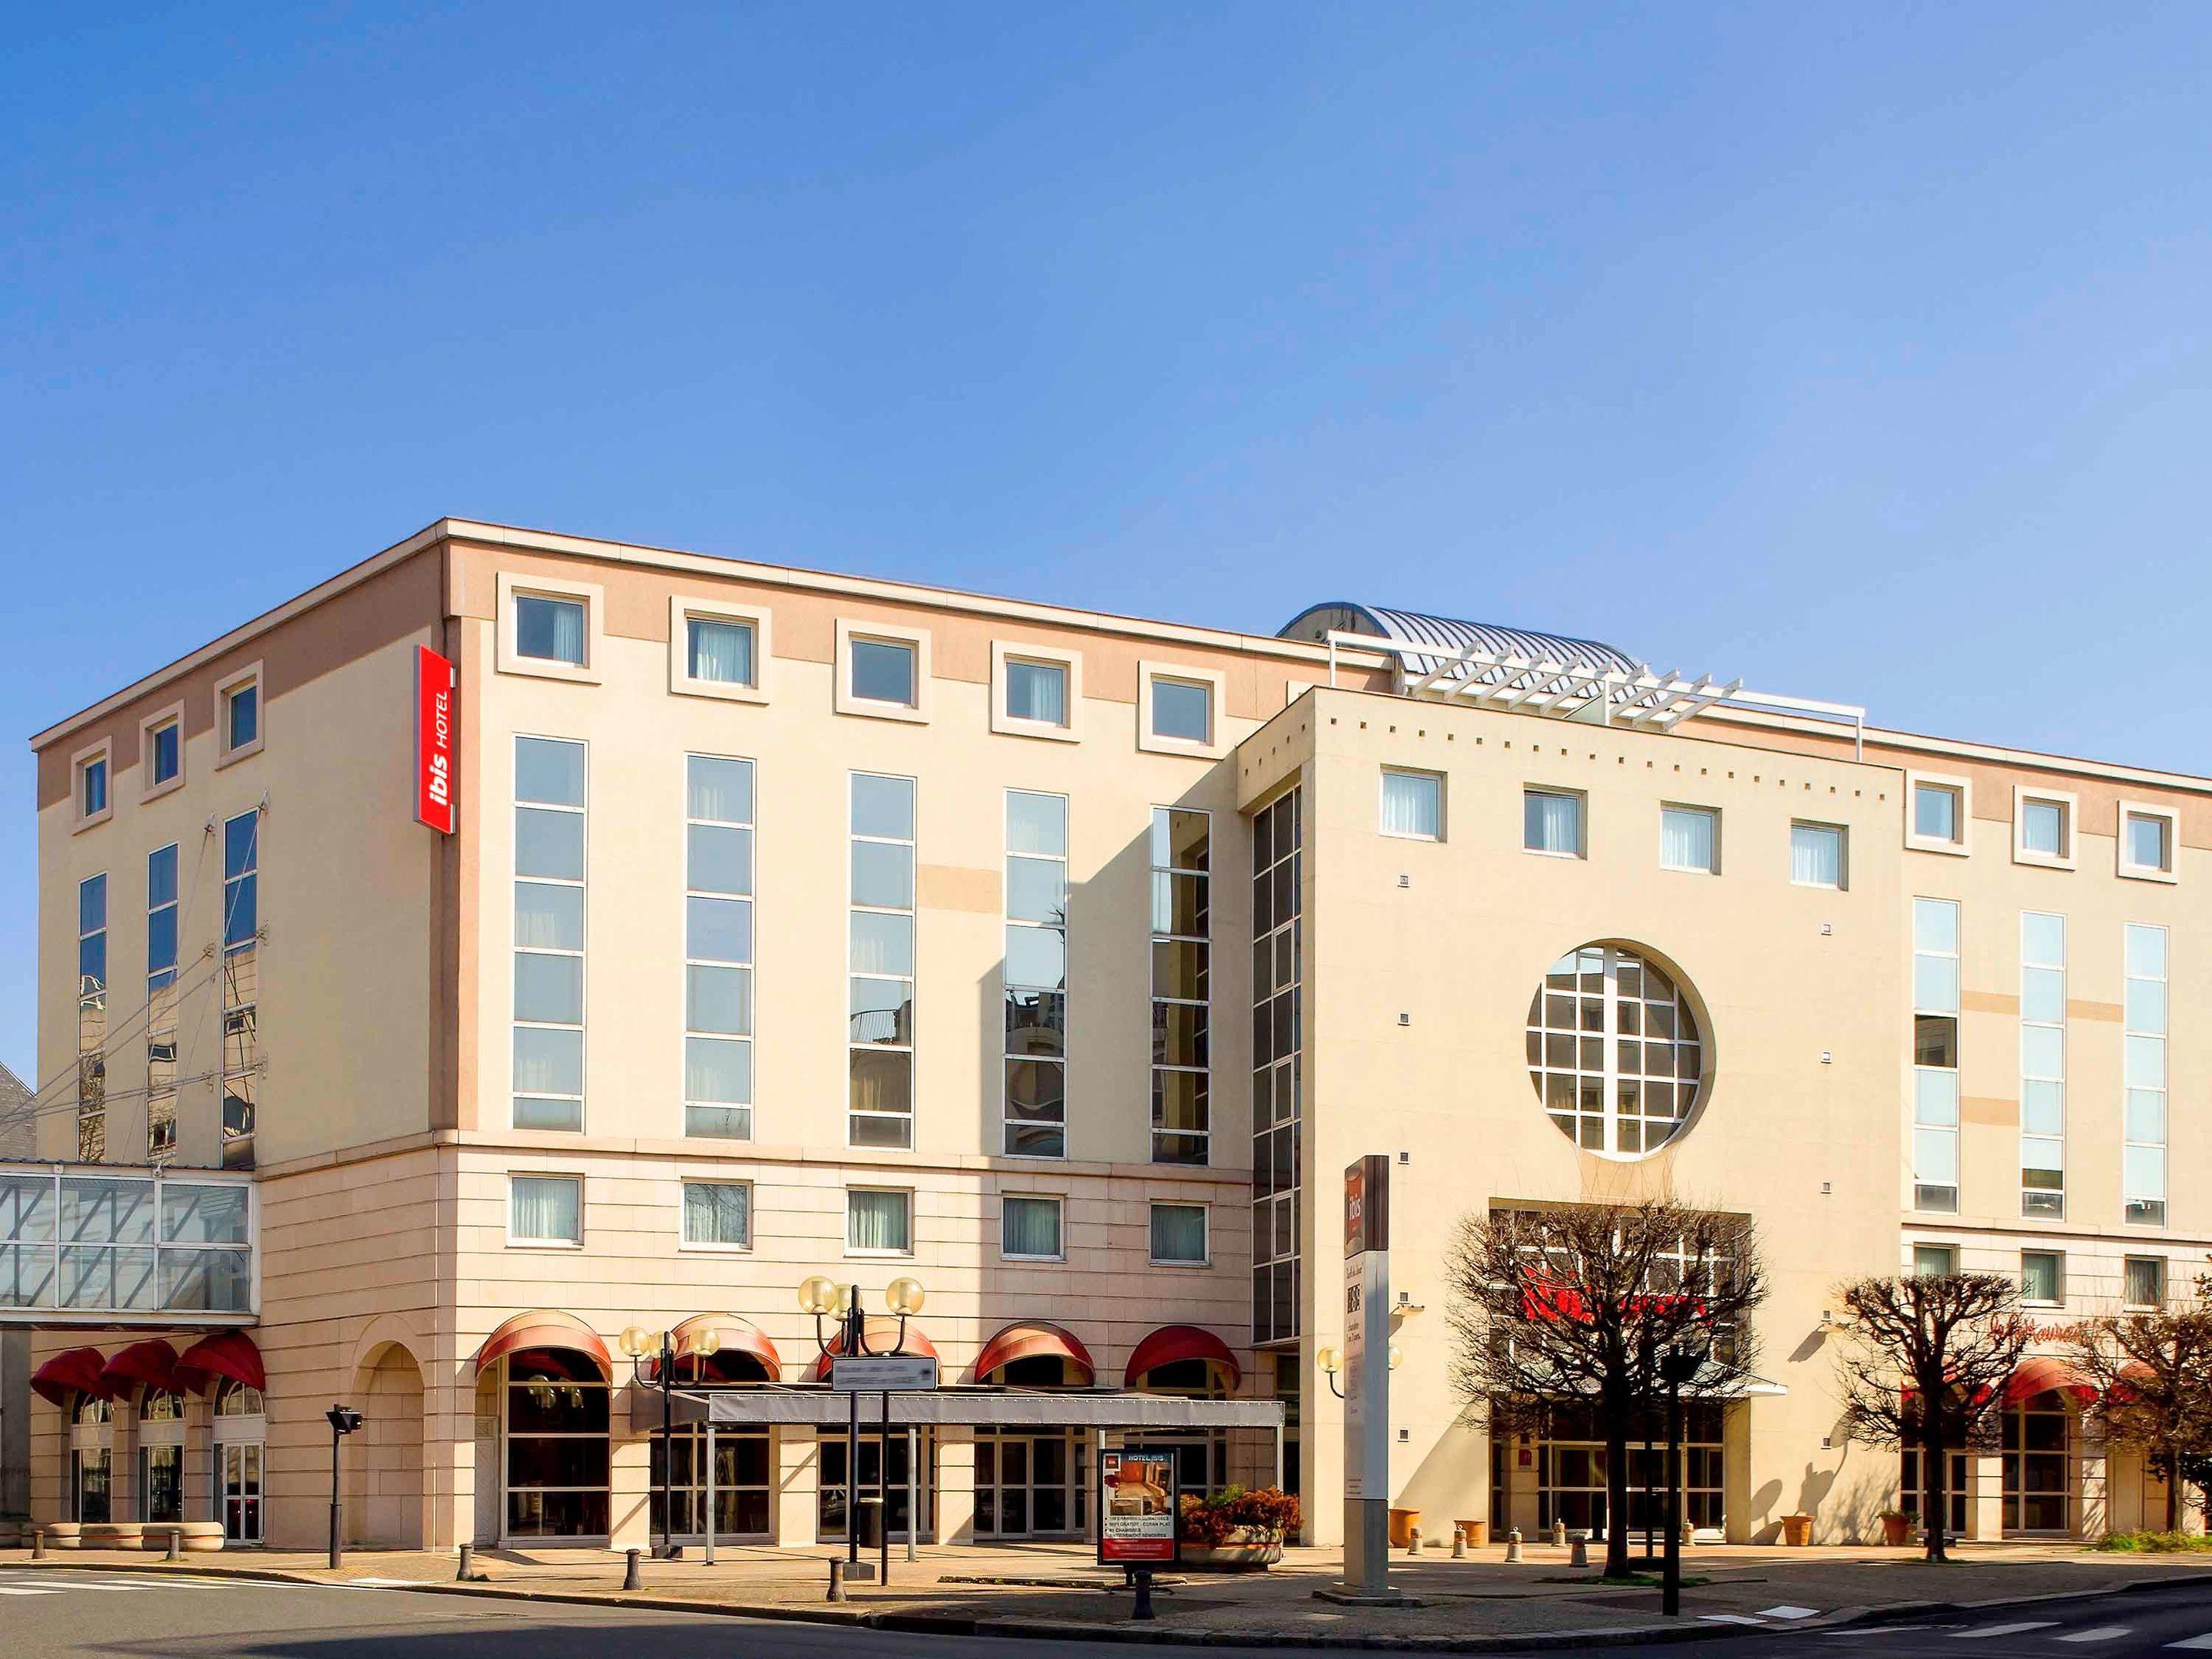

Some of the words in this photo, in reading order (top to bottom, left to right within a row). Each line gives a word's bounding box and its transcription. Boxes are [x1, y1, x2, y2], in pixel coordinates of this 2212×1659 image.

[436, 691, 448, 749] HOTEL
[429, 753, 448, 806] ibis
[1349, 1193, 1361, 1221] ibis
